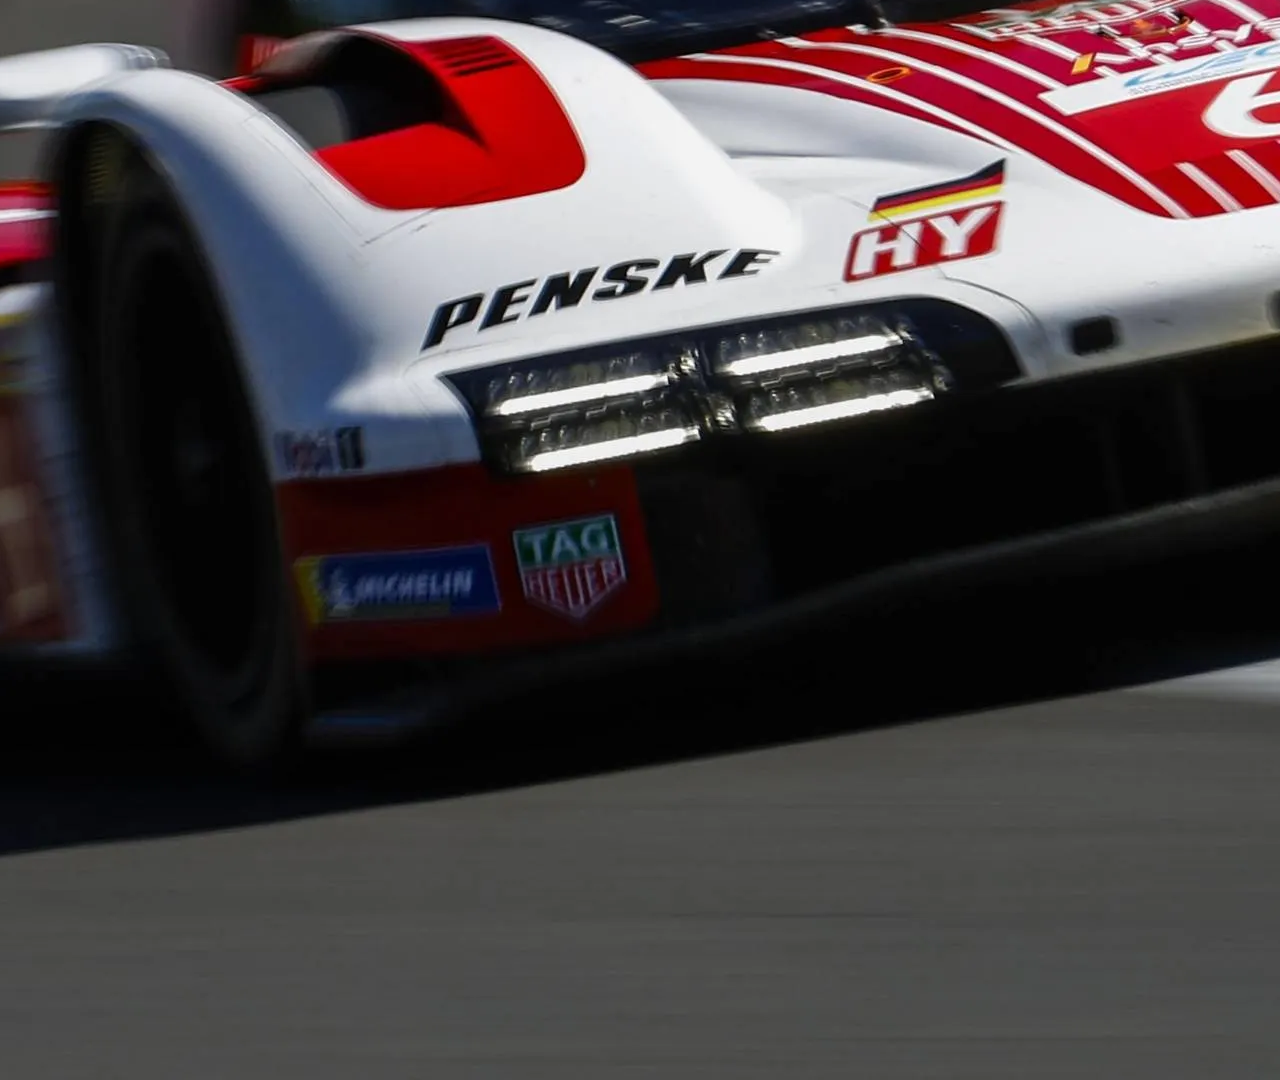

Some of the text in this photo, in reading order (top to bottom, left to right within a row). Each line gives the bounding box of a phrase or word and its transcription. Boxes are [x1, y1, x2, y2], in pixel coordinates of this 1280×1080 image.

[851, 205, 998, 277] HY
[422, 248, 780, 350] PENSKE
[523, 522, 609, 567] TAG
[354, 568, 474, 604] MICHELIN
[522, 557, 623, 614] HEUER
